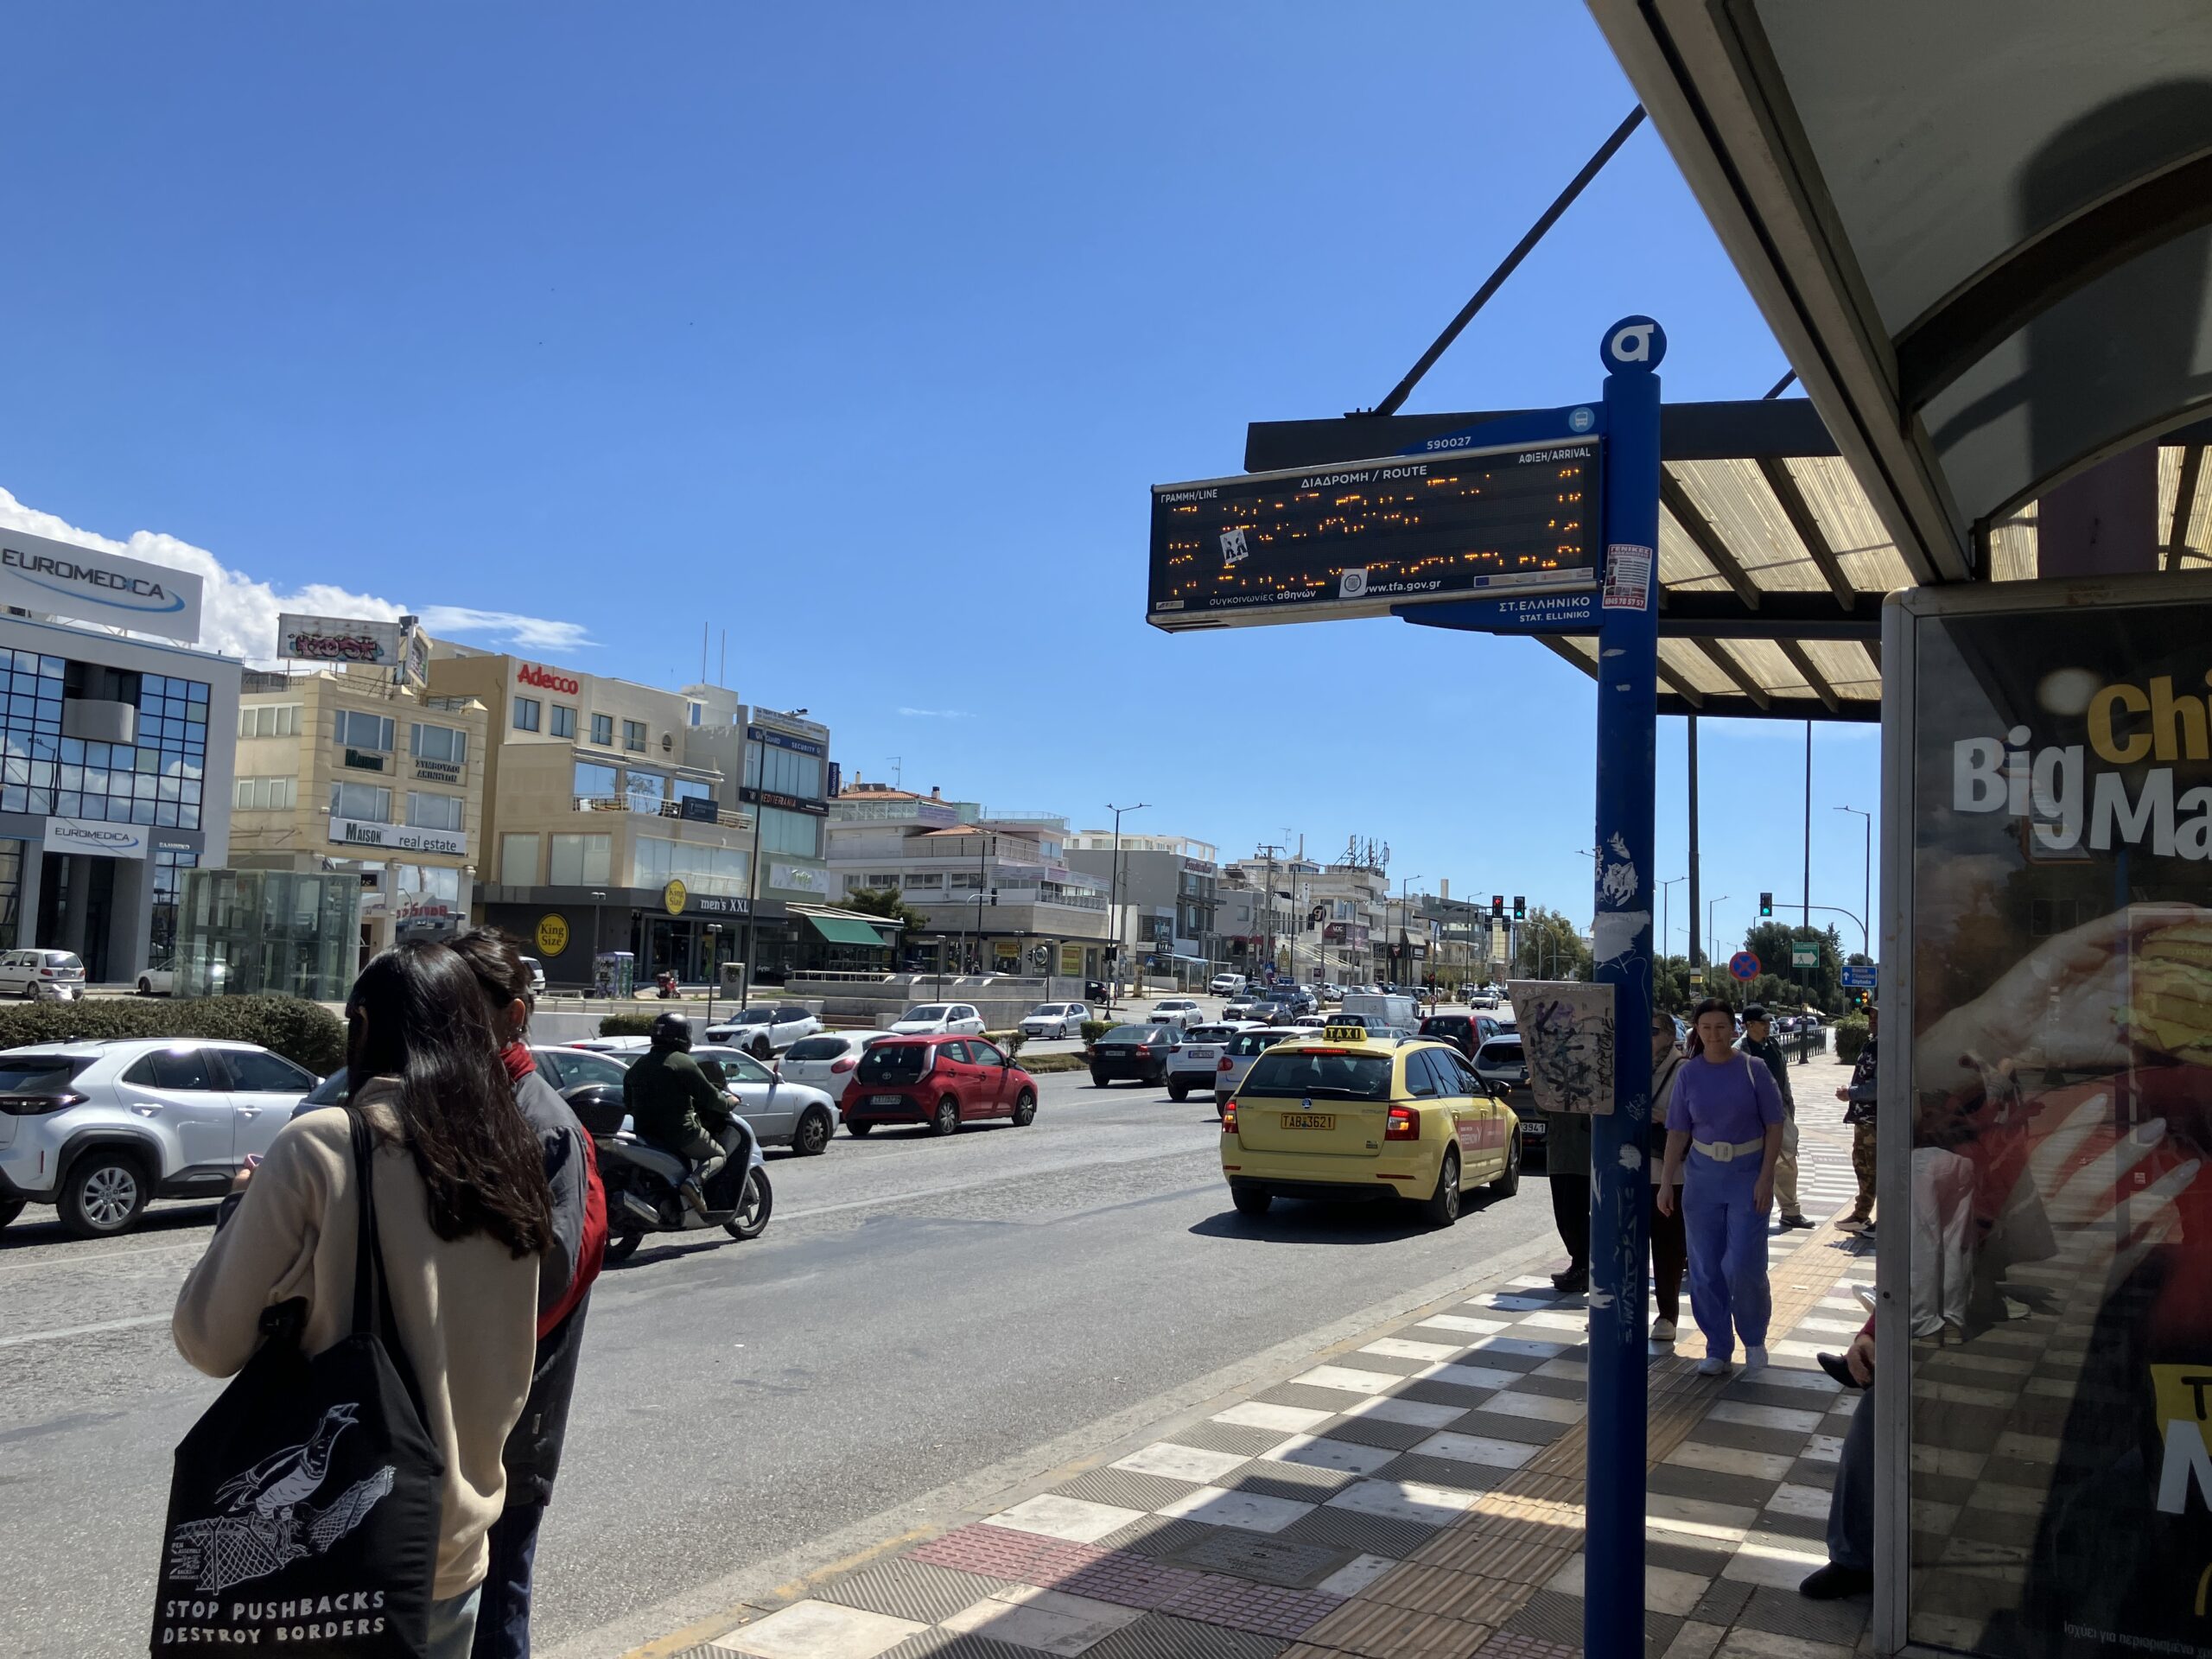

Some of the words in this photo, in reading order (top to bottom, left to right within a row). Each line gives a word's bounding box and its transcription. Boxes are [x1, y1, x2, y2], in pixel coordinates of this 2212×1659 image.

[1427, 436, 1471, 449] 590027
[1519, 448, 1591, 464] ΑΦΙΞΗ/ARRIVAL
[1300, 472, 1370, 488] ΔΙΑΔΡΟΜΗ
[1382, 465, 1427, 480] ROUTE
[1160, 488, 1217, 504] ΓΡΑΜΜΗ/LINE
[2, 548, 165, 601] EUROMEDICA
[1209, 591, 1274, 607] συγκοινωνίες
[1276, 588, 1316, 601] αθηνών
[1499, 596, 1591, 611] ΣΤ.ΕΛΛΗΝΙΚΟ
[1519, 613, 1542, 622] STAT.
[1546, 610, 1590, 620] ELLINIKO
[518, 664, 579, 695] Adecco
[2088, 675, 2212, 764] Ch
[1954, 724, 2084, 850] Big
[54, 827, 130, 842] EUROMEDICA
[399, 836, 420, 848] real
[423, 840, 457, 852] estate
[669, 886, 685, 897] King
[669, 895, 683, 907] Size
[700, 899, 727, 912] men's
[729, 899, 749, 913] XXL
[541, 925, 565, 940] King
[541, 936, 563, 946] Size
[1328, 1029, 1361, 1039] TAXI
[1306, 1116, 1332, 1128] 3621
[166, 1600, 219, 1618] STOP
[232, 1591, 385, 1620] PUSHBACKS
[163, 1628, 260, 1643] DESTROY
[276, 1618, 385, 1641] BORDERS
[2063, 1620, 2097, 1639] Ισχύει
[2100, 1630, 2116, 1643] για
